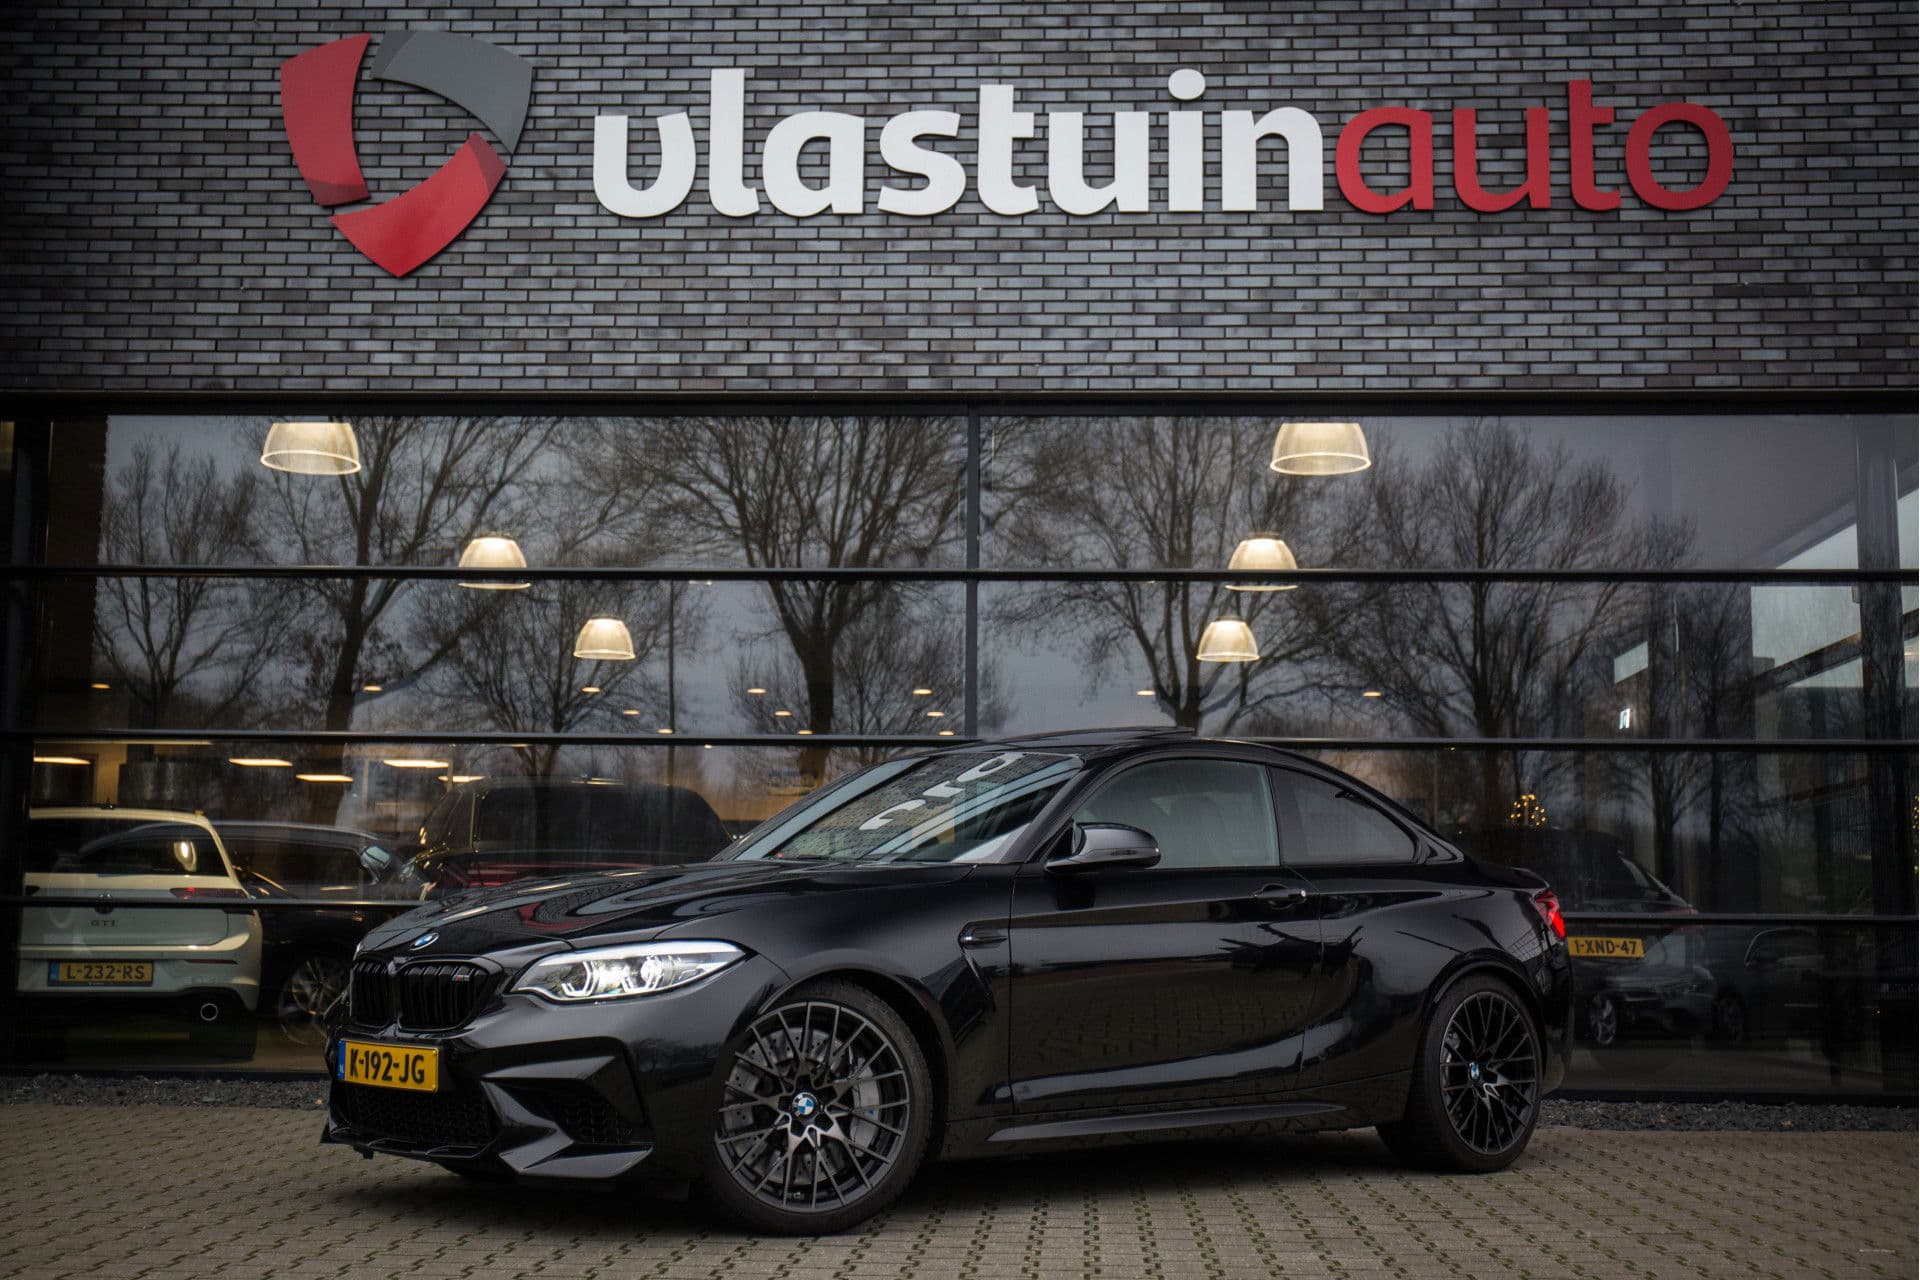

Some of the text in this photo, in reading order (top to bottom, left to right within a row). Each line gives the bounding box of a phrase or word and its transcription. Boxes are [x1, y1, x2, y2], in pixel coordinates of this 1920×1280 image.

[1574, 939, 1637, 955] 1-XND-47
[66, 964, 145, 980] L-232-RS
[350, 1047, 425, 1085] K-192-JG
